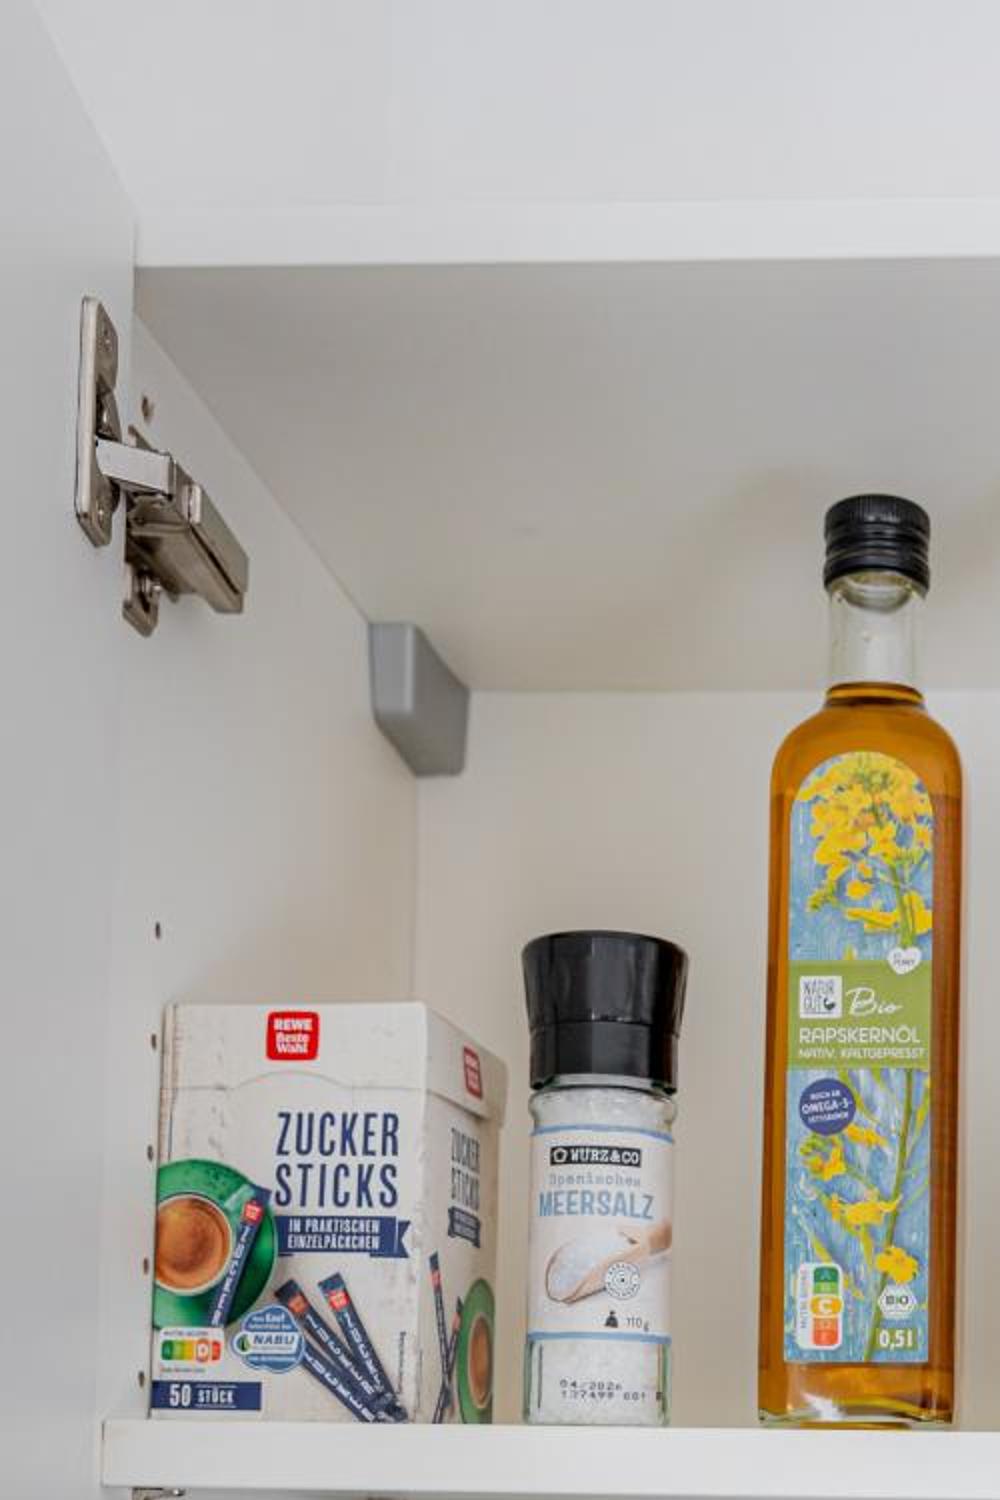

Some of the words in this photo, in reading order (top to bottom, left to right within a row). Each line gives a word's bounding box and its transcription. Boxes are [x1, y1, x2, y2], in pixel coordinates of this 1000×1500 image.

[845, 986, 903, 1016] Bio
[273, 1017, 313, 1031] REWE
[275, 1032, 310, 1043] Beste
[798, 1025, 921, 1044] RAPSKERNÖL
[276, 1042, 309, 1054] Wahl
[276, 1111, 400, 1157] ZUCKER
[275, 1163, 399, 1209] STICKS
[538, 1188, 655, 1220] MEERSALZ
[289, 1218, 301, 1234] IN
[305, 1218, 381, 1235] PRAKTISCHEN
[287, 1233, 381, 1249] EINZELPÄCKCHEN
[253, 1334, 296, 1346] NABU
[169, 1383, 192, 1407] 50
[197, 1385, 234, 1404] STÜCK
